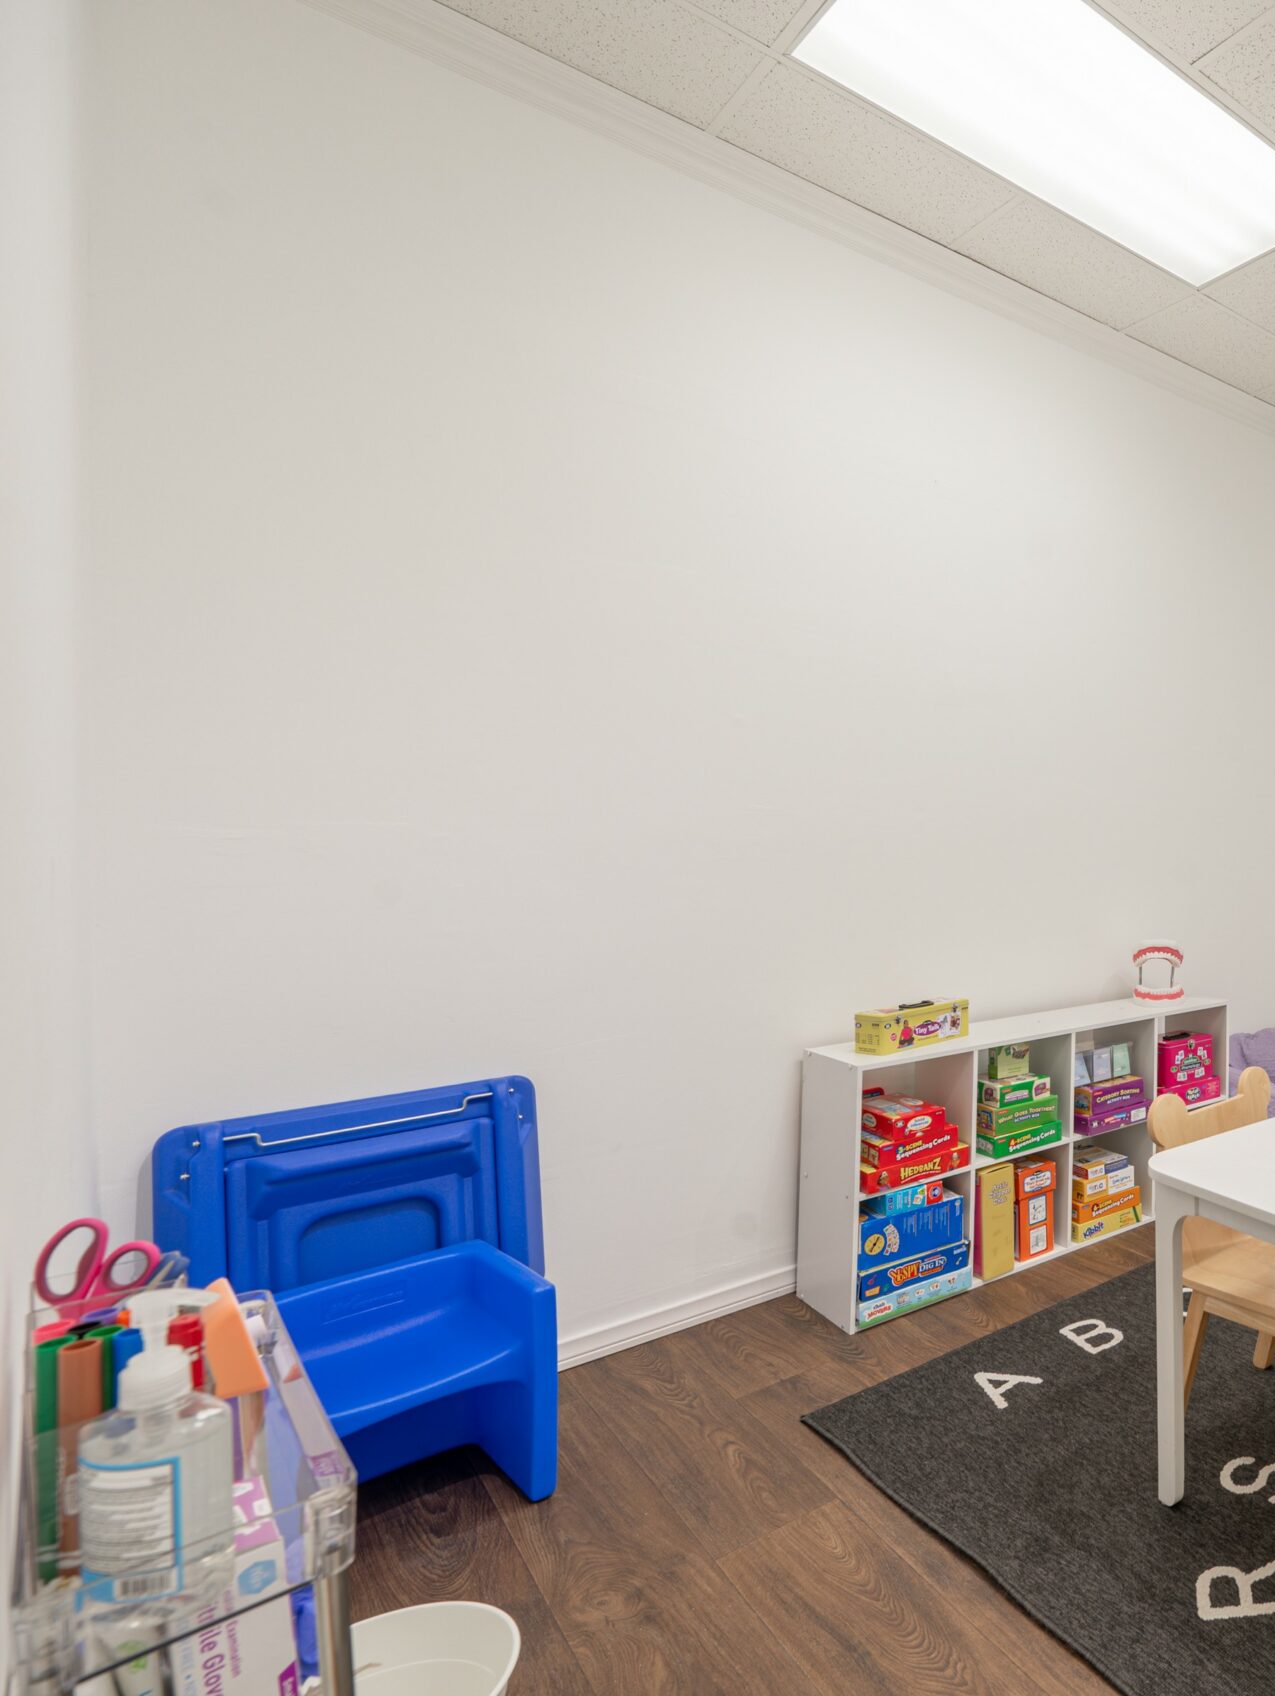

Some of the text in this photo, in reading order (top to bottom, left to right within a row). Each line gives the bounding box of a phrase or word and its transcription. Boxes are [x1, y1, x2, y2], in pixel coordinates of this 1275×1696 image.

[915, 1026, 928, 1035] Tiny
[1096, 1091, 1120, 1103] CATEGORY
[1120, 1088, 1140, 1096] SORTING
[1107, 1096, 1122, 1104] ACTIVITY
[998, 1114, 1013, 1124] WHAT
[1014, 1115, 1031, 1123] ACTIVITY
[896, 1135, 951, 1161] Sequencing Cards
[1009, 1129, 1056, 1152] Sequencing Cards
[1092, 1194, 1134, 1217] Sequencing Cards
[919, 1260, 934, 1272] DIG
[934, 1257, 945, 1267] IN
[1058, 1318, 1124, 1354] B
[973, 1370, 1044, 1409] A
[226, 1620, 242, 1679] Examination
